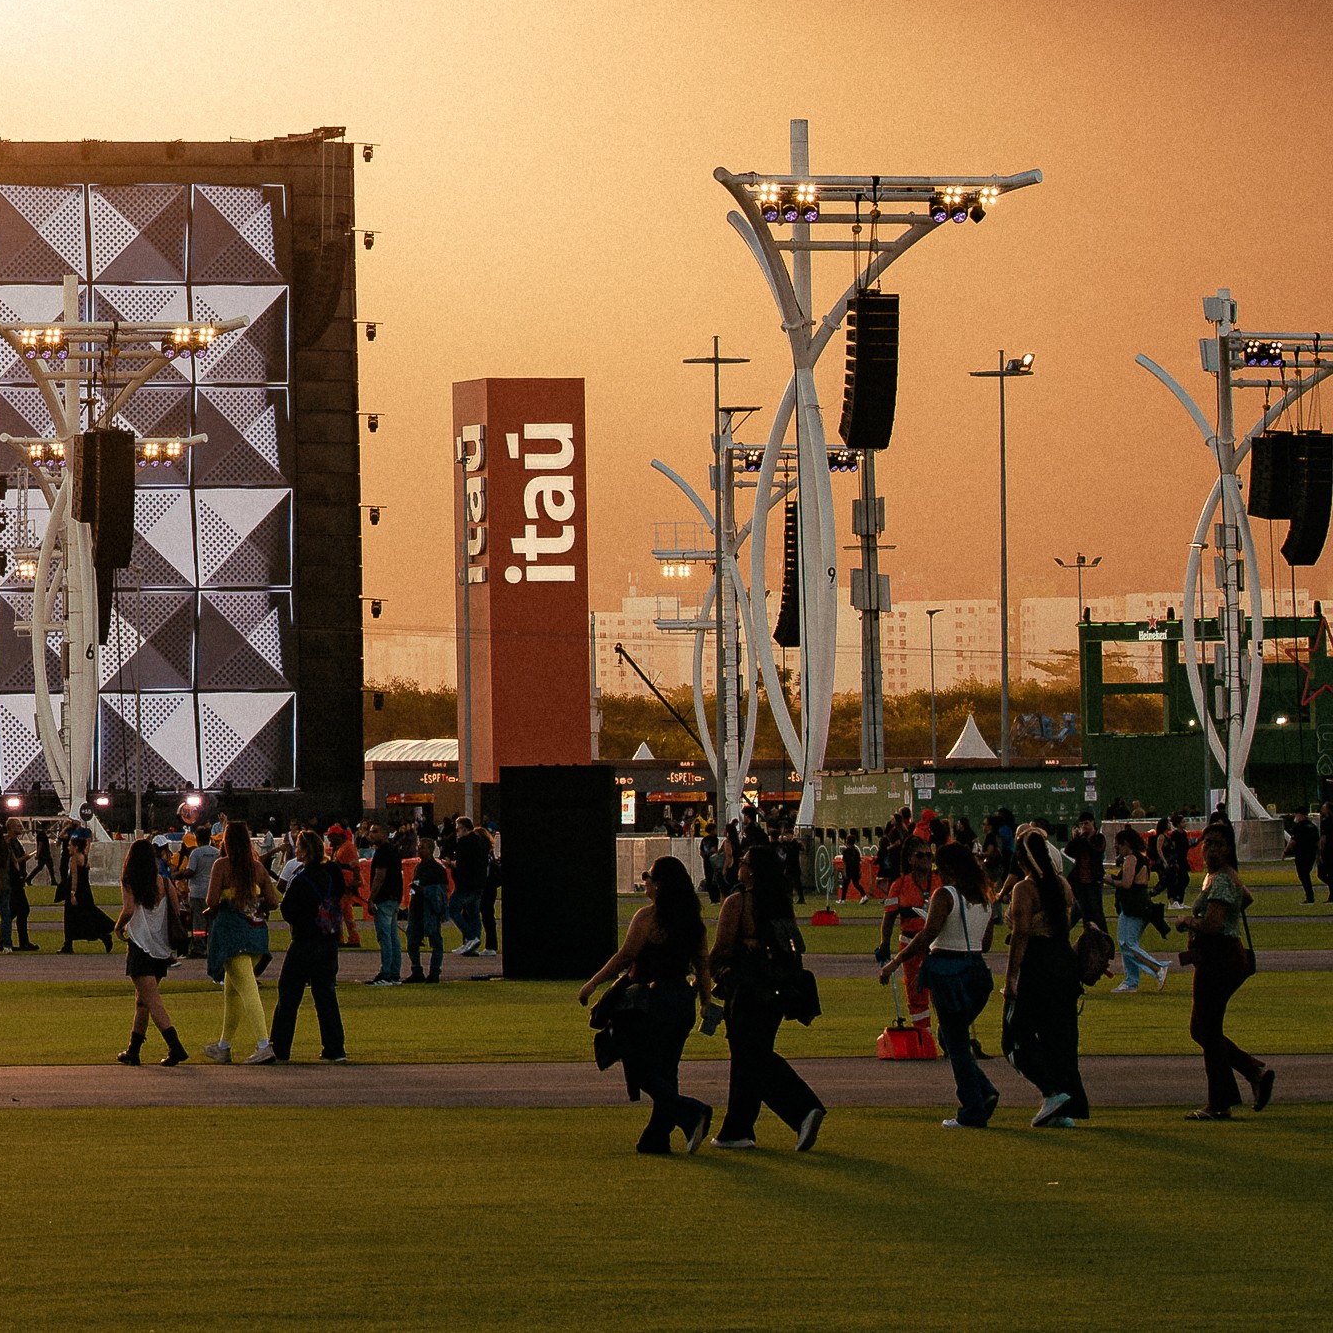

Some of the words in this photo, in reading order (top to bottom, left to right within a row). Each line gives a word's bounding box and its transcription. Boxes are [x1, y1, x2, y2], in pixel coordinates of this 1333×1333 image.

[505, 423, 576, 584] itaú
[827, 566, 837, 584] 9
[1138, 629, 1168, 641] Heineken
[85, 642, 95, 660] 6
[971, 781, 1042, 791] Autoatendimento
